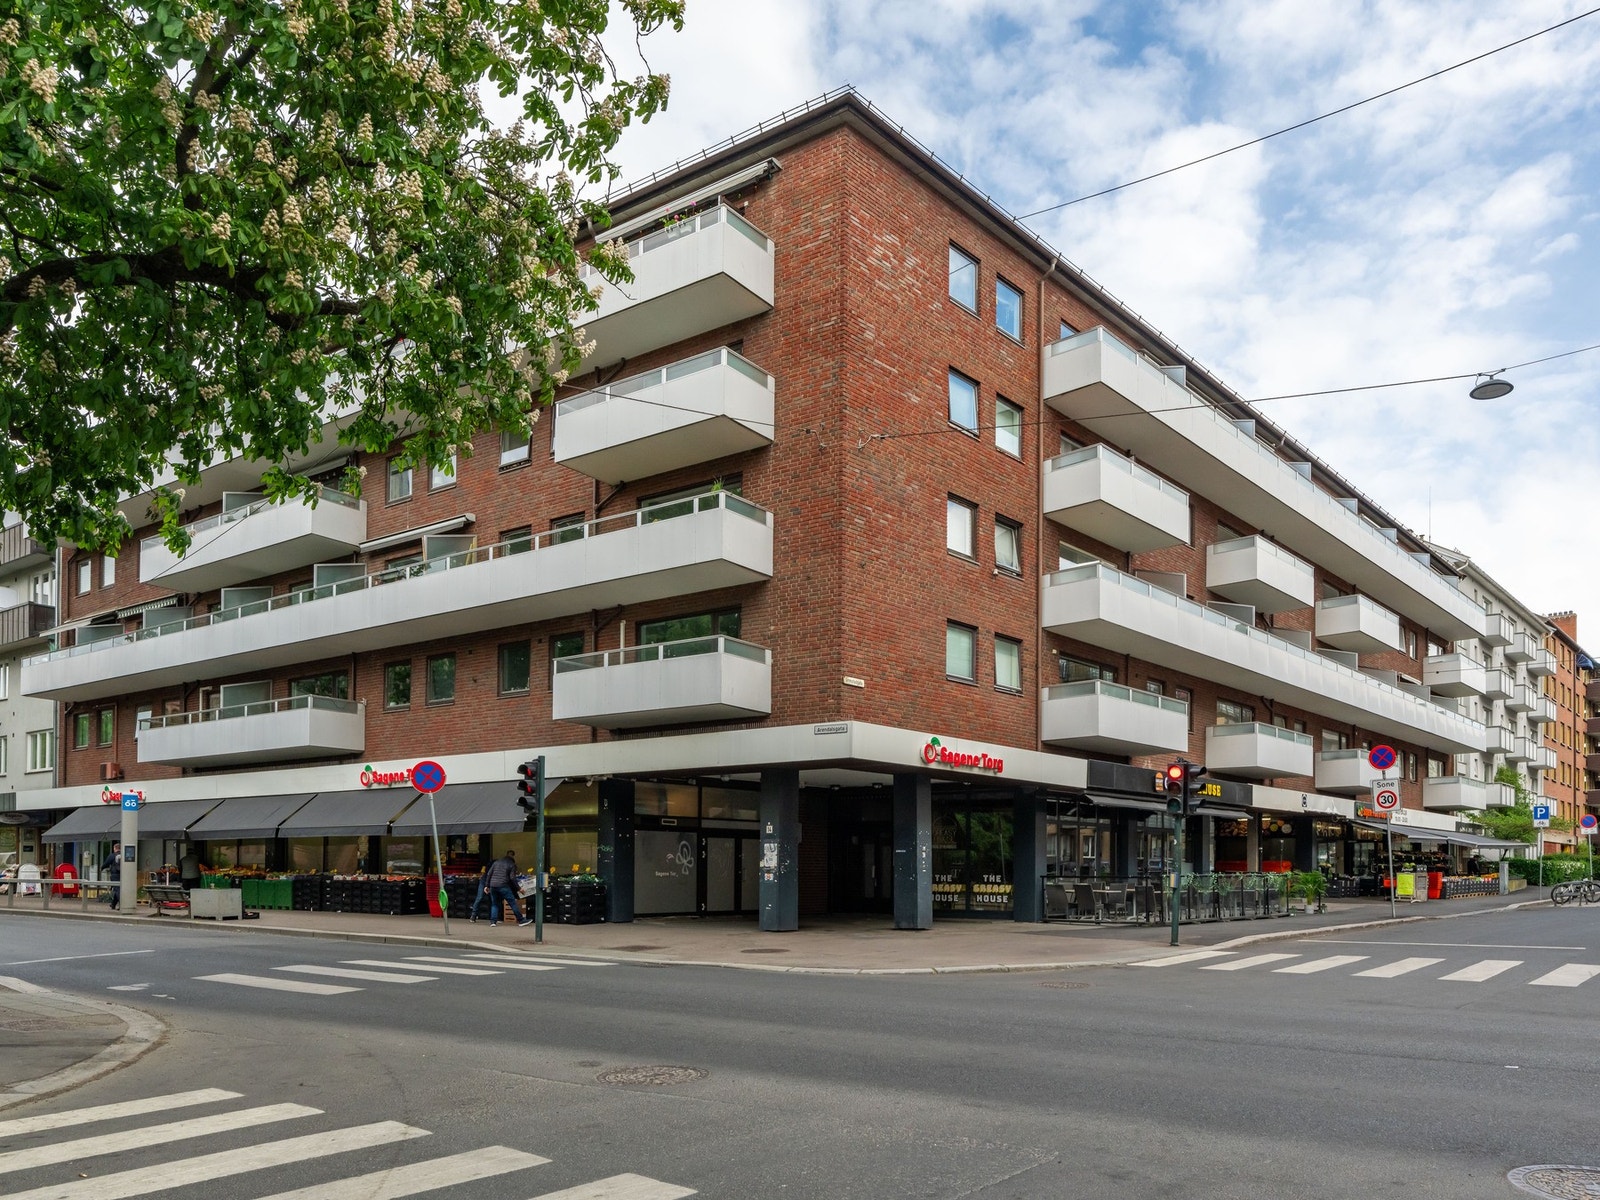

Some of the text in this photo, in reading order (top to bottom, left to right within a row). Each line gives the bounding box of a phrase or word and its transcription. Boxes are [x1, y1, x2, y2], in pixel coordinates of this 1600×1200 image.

[940, 746, 1003, 773] Sagene Torg
[372, 771, 404, 786] Sagene
[1380, 795, 1394, 805] 30
[1537, 807, 1546, 818] P
[934, 874, 953, 882] THE
[982, 874, 1002, 882] THE
[972, 884, 1012, 893] GREASY
[976, 894, 1009, 903] HOUSE
